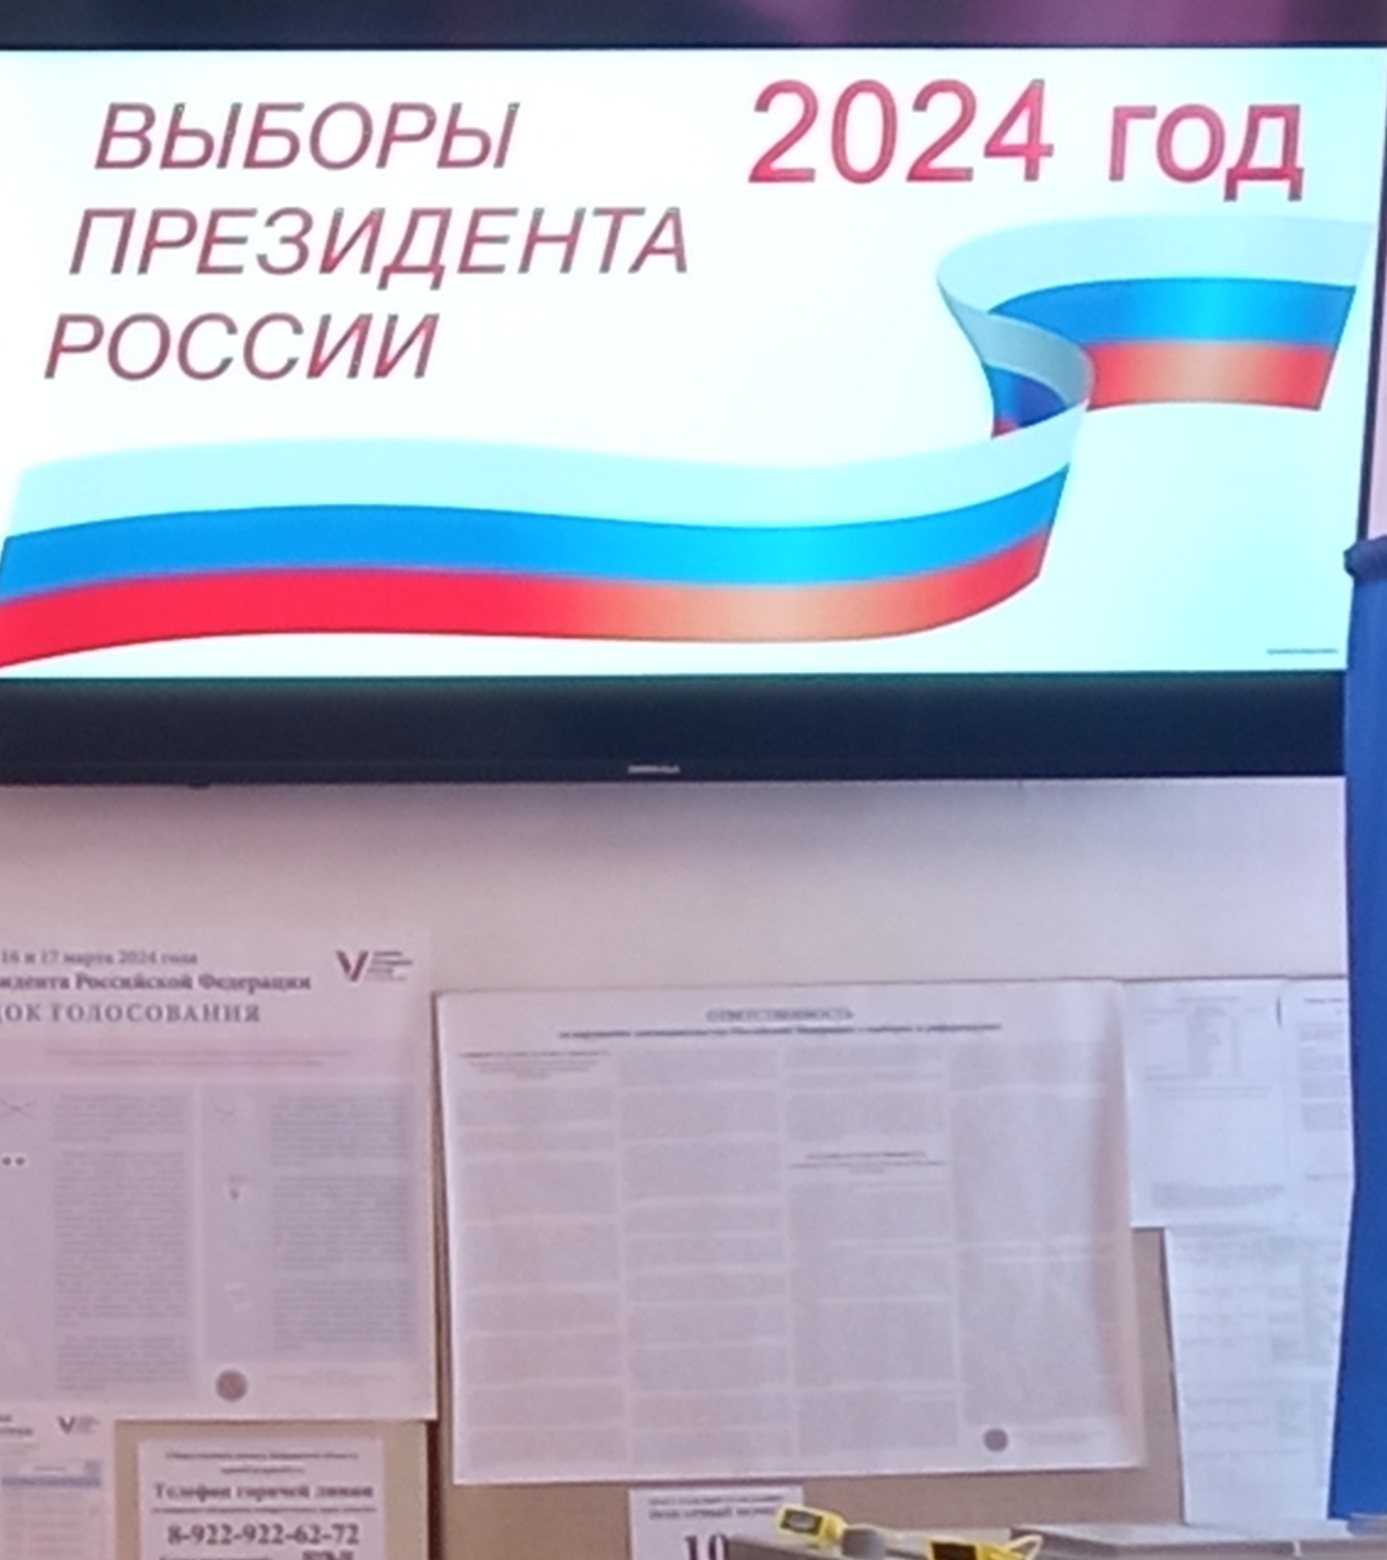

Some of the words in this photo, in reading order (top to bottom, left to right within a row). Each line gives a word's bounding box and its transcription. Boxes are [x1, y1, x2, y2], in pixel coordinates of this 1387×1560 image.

[94, 101, 520, 170] ВЫБОРЫ
[748, 78, 1054, 184] 2024
[1108, 103, 1305, 202] год
[68, 206, 688, 291] ПРЕЗИДЕНТА
[43, 312, 440, 381] РОССИИ
[1, 950, 20, 964] 16
[63, 953, 114, 968] марта
[119, 950, 157, 965] 2024
[76, 972, 192, 990] Российской
[198, 973, 311, 995] Федерации
[51, 1003, 260, 1023] ГОЛОСОВАНИЯ
[155, 1484, 231, 1503] Телефон
[236, 1485, 309, 1503] горячей
[167, 1523, 359, 1545] 8-922-922-62-72
